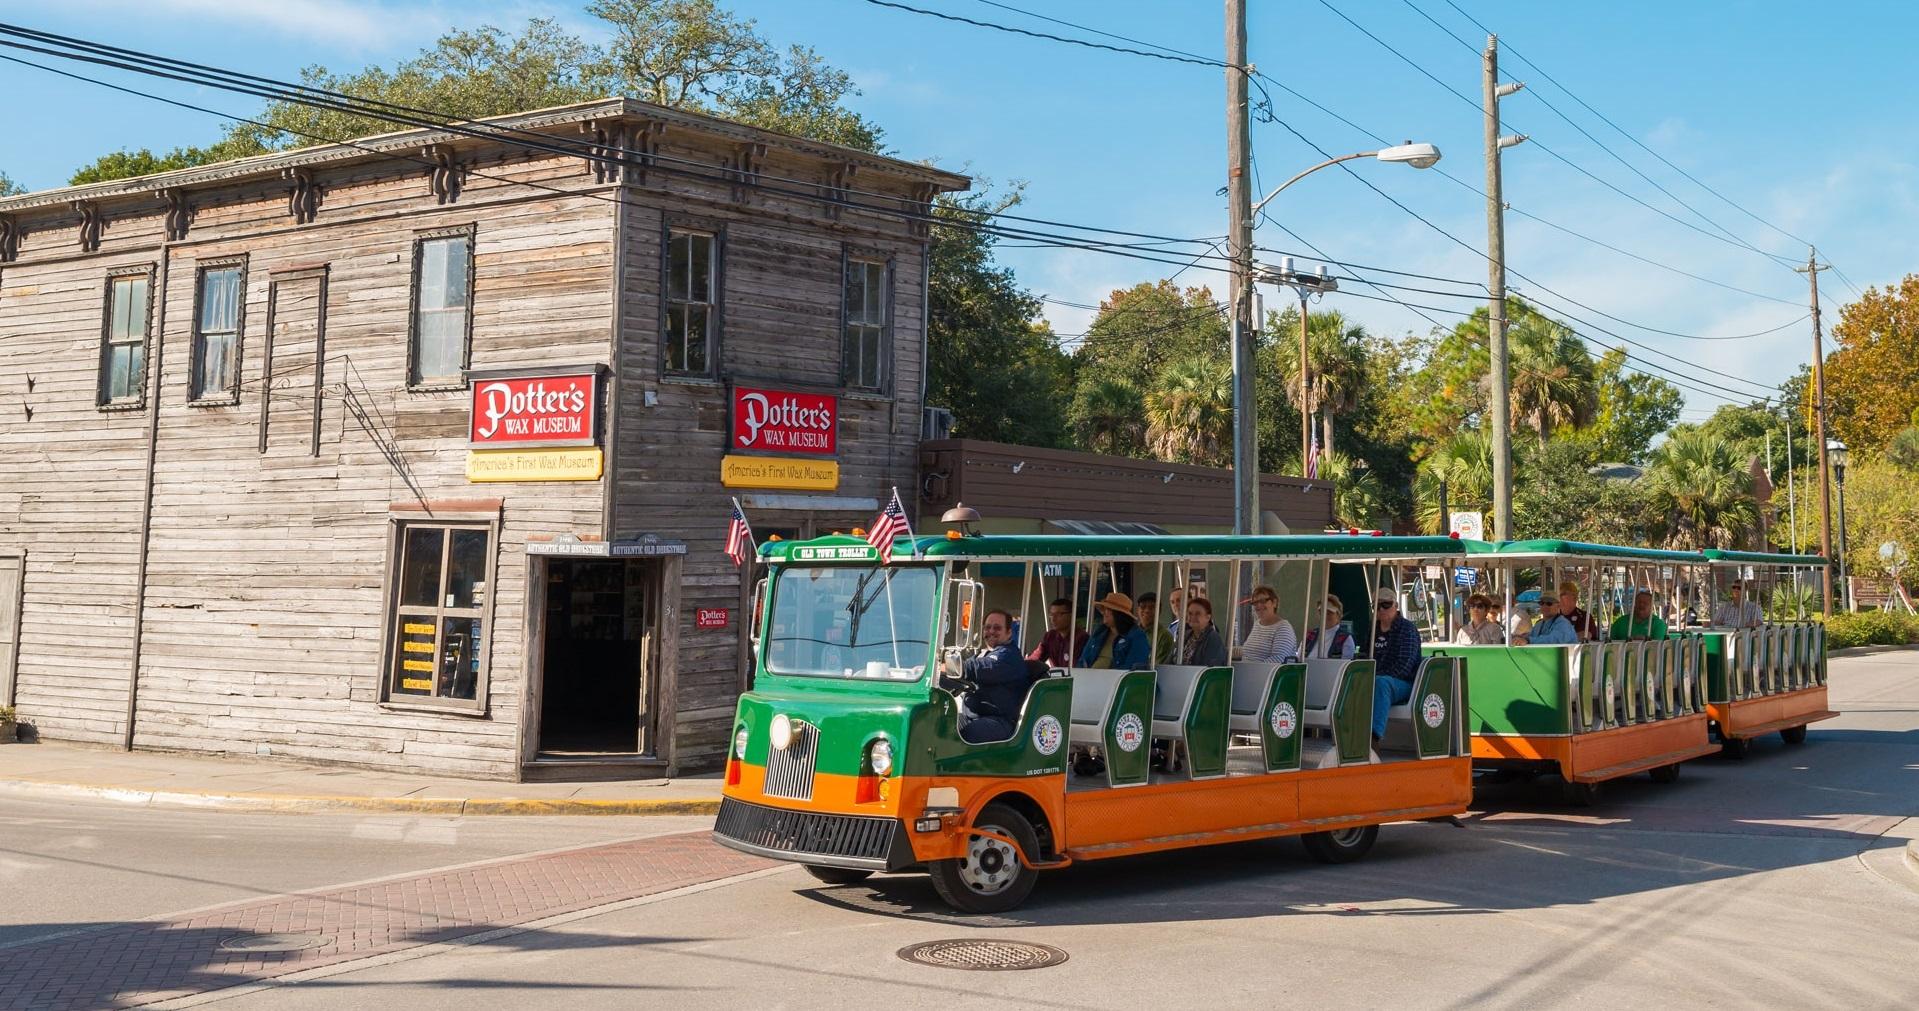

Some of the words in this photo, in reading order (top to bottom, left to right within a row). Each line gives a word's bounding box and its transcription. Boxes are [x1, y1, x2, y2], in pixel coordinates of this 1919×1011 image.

[478, 382, 585, 438] Potter's
[505, 418, 529, 435] WAX
[533, 416, 581, 434] MUSEUM
[739, 392, 831, 446] Potter's
[763, 429, 785, 446] WAX
[788, 431, 828, 448] MUSEUM
[471, 456, 514, 472] America's
[516, 455, 537, 469] First
[539, 455, 557, 469] Wax
[558, 454, 595, 469] Museum
[727, 463, 767, 478] America's
[768, 465, 786, 478] First
[787, 466, 803, 480] Wax
[804, 466, 834, 480] Museum
[612, 545, 644, 555] AUTHENTIC
[644, 545, 656, 554] OLD
[801, 548, 814, 559] OLD
[816, 548, 836, 558] TOWN
[838, 547, 869, 558] TROLLEY
[1044, 564, 1062, 577] ATM
[699, 610, 726, 625] Potter's
[925, 676, 931, 687] 7
